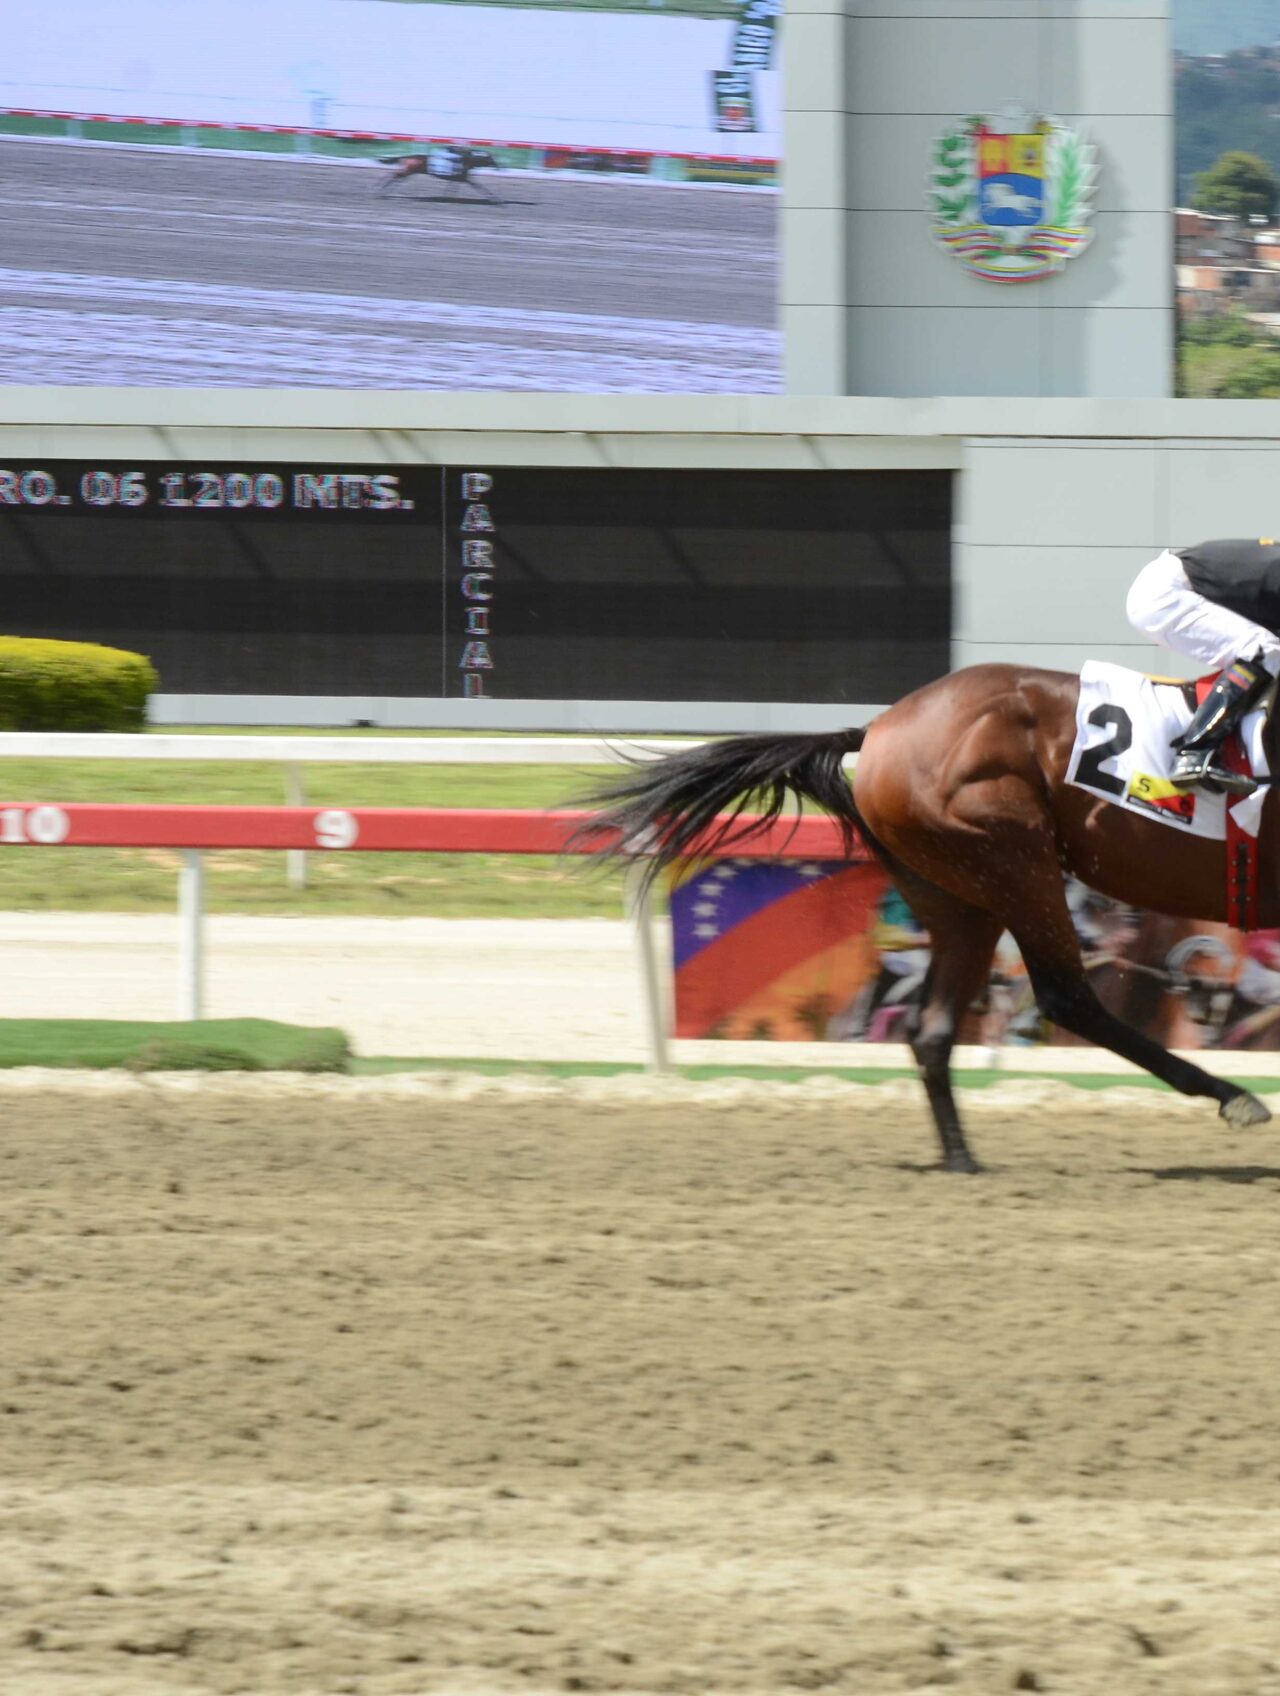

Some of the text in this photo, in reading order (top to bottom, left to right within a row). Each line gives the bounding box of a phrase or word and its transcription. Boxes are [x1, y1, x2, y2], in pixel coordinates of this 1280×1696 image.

[159, 472, 284, 508] 1200
[294, 474, 415, 510] MTS.
[461, 472, 496, 698] PARCIAL
[1074, 703, 1133, 796] 2
[0, 807, 69, 843] 10
[315, 810, 358, 848] 9
